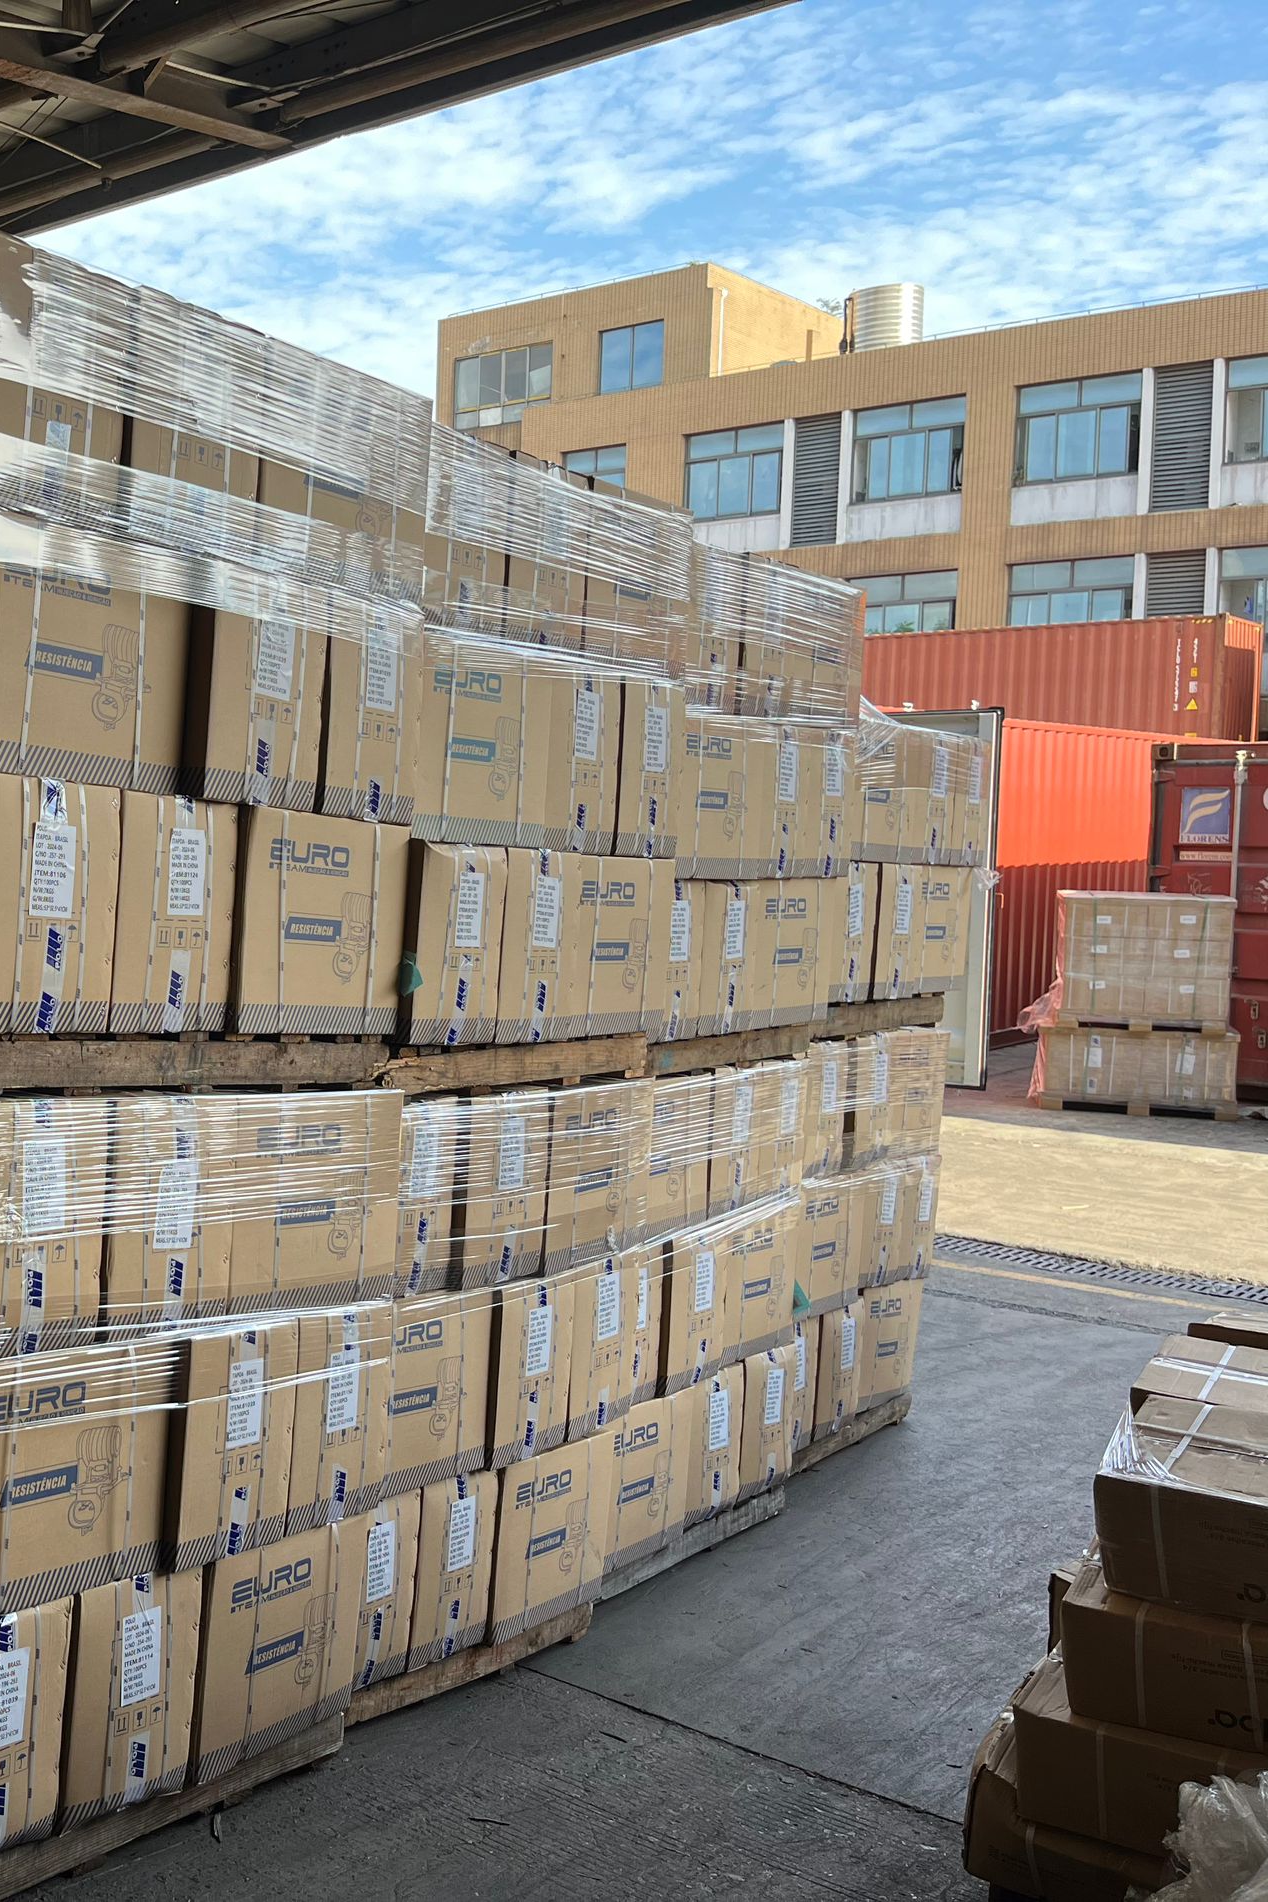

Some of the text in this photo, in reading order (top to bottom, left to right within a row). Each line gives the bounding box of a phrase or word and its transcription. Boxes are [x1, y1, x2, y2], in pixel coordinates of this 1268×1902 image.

[36, 650, 92, 672] RESISTÊNCIA
[271, 839, 349, 868] EURO
[582, 881, 635, 900] EURO
[290, 923, 333, 936] RESISTÊNCIA
[12, 1475, 66, 1498] RESISTÊNCIA
[517, 1469, 571, 1502] EURO
[232, 1558, 311, 1604] EURO
